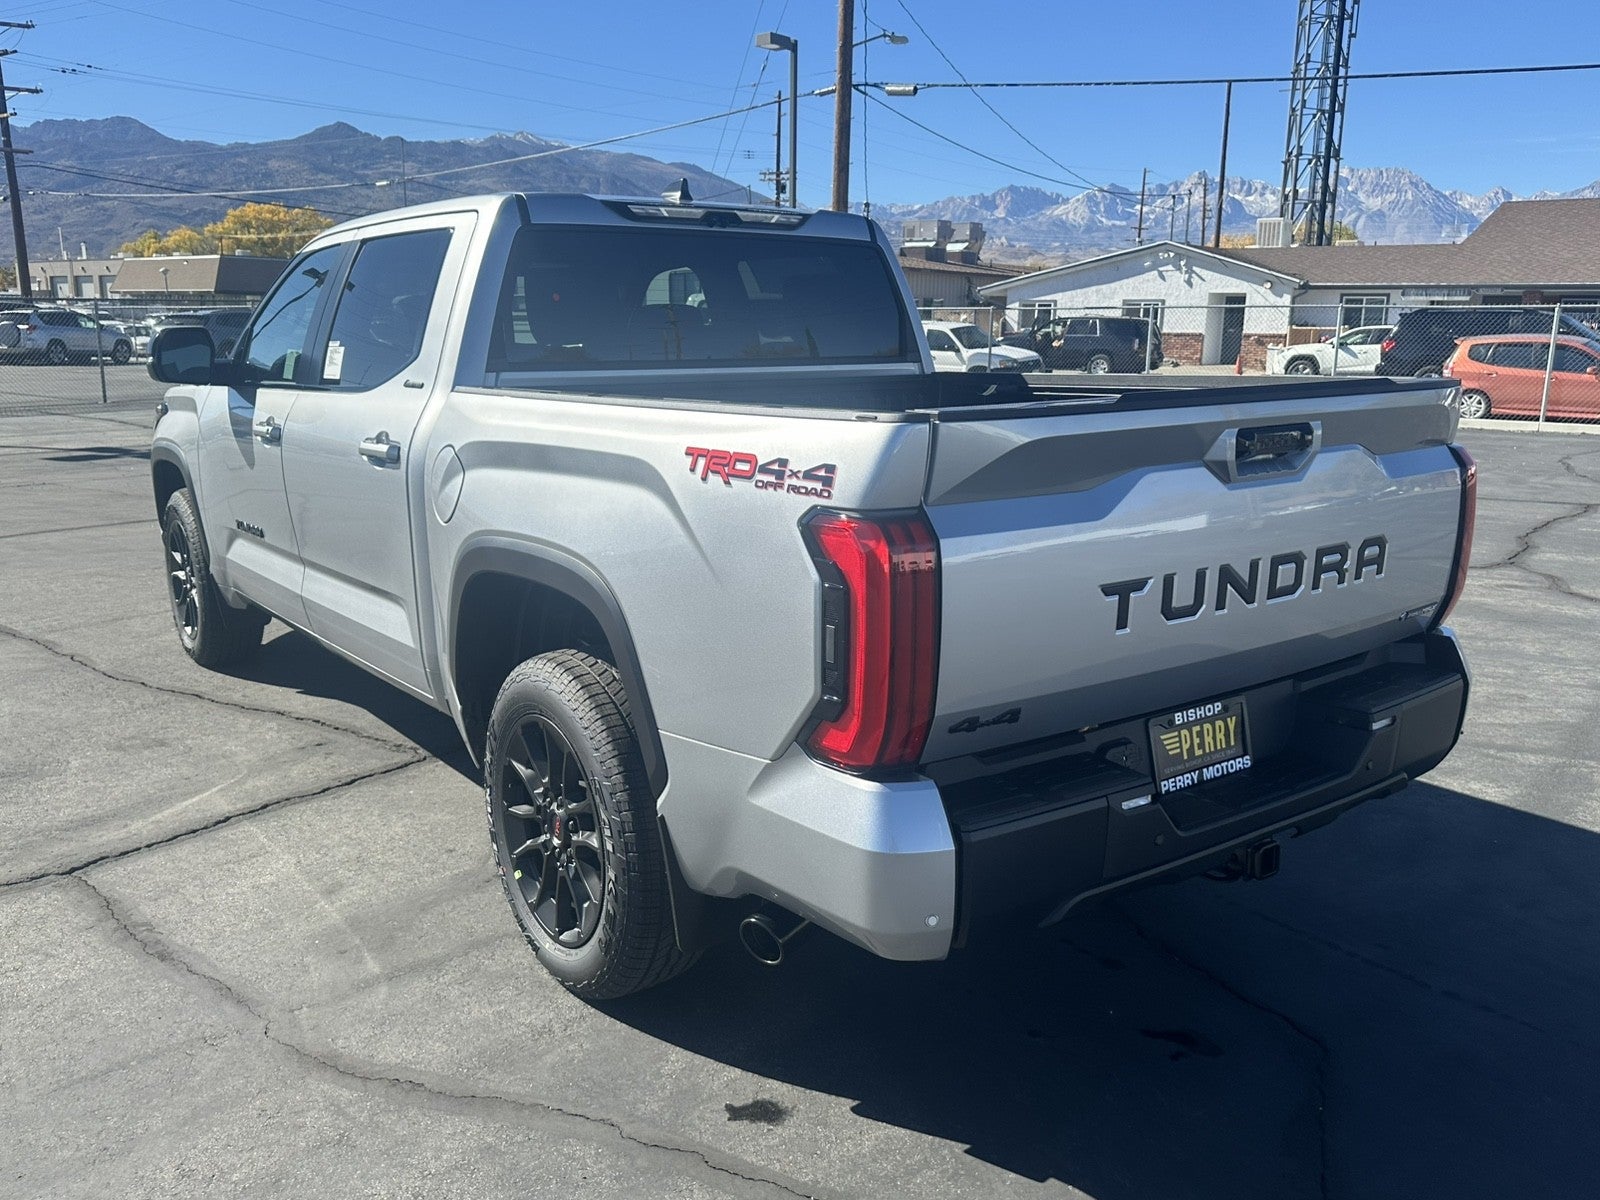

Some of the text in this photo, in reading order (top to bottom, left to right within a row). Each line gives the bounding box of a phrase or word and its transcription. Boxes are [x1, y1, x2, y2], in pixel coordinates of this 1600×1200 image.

[685, 446, 758, 487] TRD
[755, 479, 833, 500] OFF ROAD
[1098, 534, 1388, 635] TUNDRA
[1174, 702, 1222, 725] BISHOP
[1180, 716, 1236, 760] PERRY
[1160, 755, 1251, 794] PERRY MOTORS
